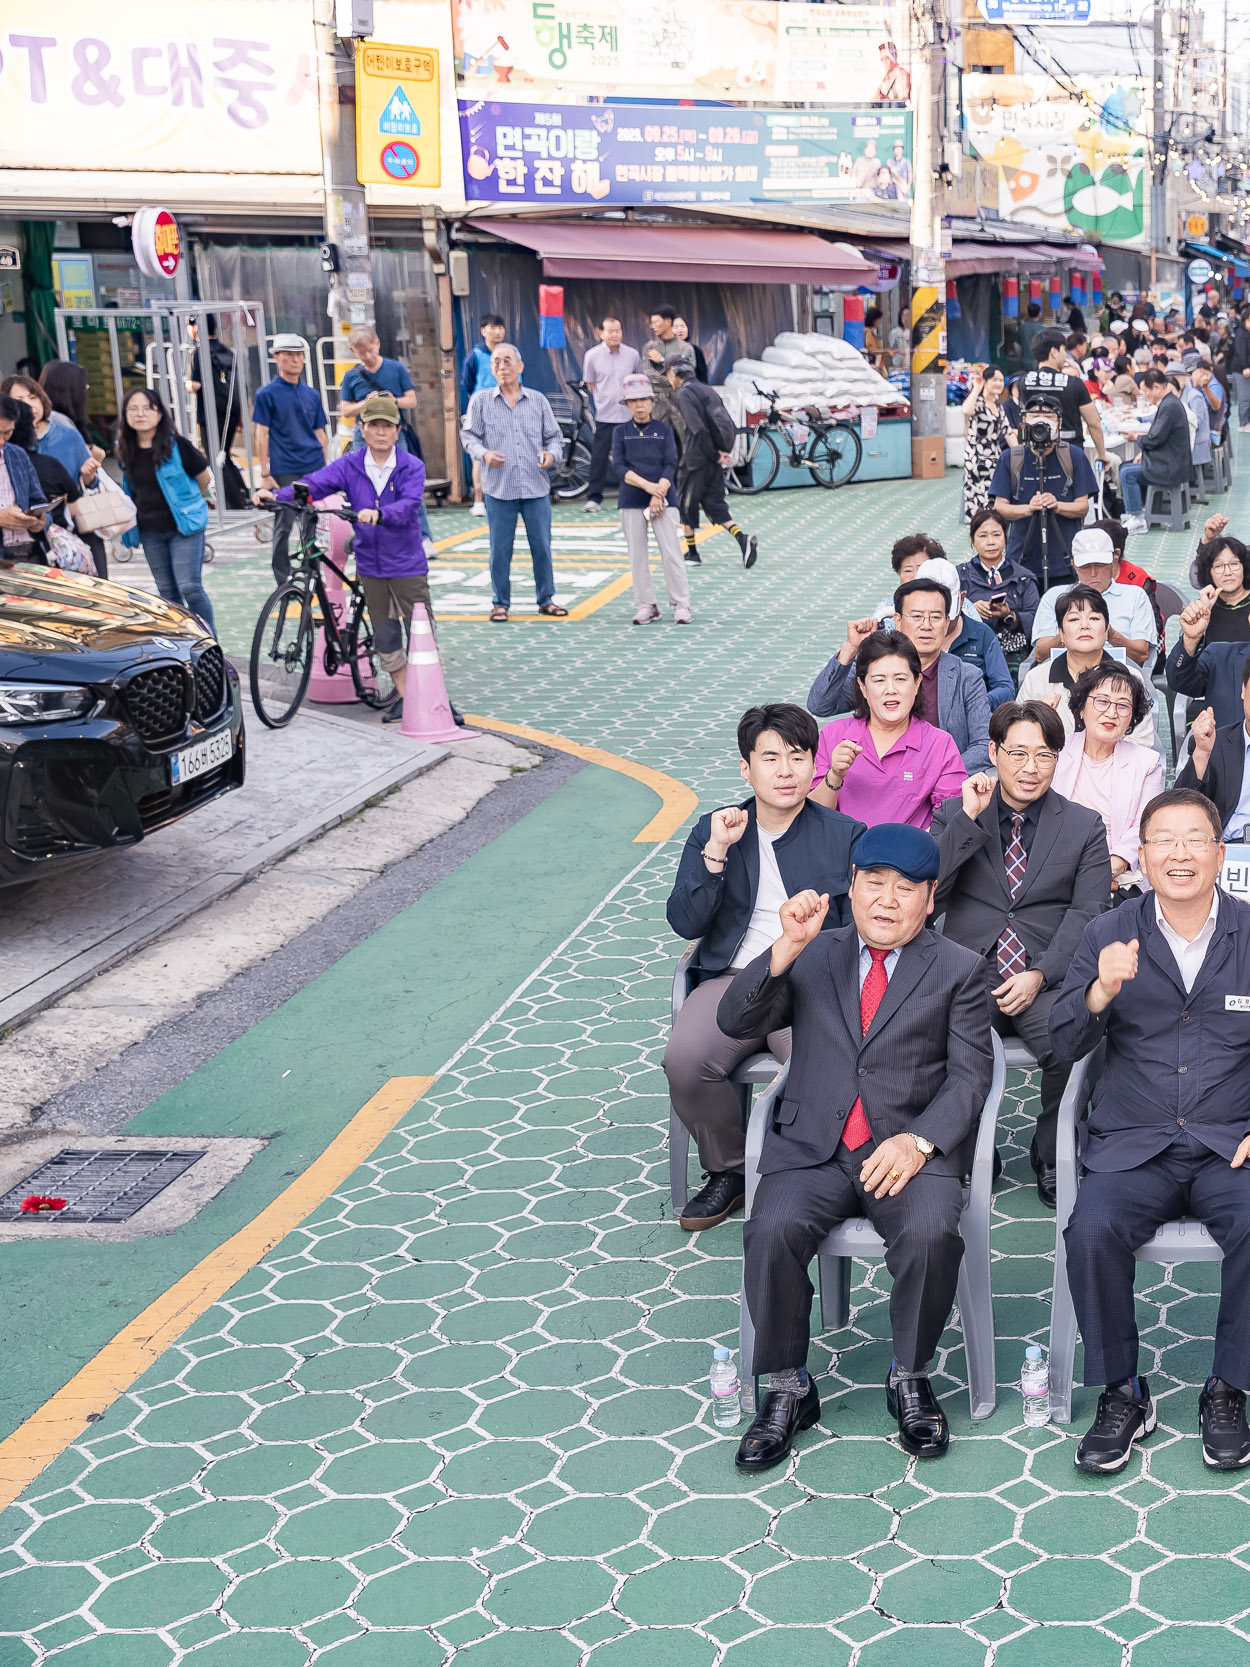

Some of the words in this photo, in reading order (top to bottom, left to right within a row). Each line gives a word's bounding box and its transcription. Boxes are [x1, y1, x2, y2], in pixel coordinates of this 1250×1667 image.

[366, 53, 432, 76] 어린이보호구역
[533, 112, 563, 127] 제5회
[495, 125, 602, 161] 면곡이랑
[654, 146, 676, 162] 오후
[494, 158, 528, 194] 한
[533, 159, 566, 195] 잔
